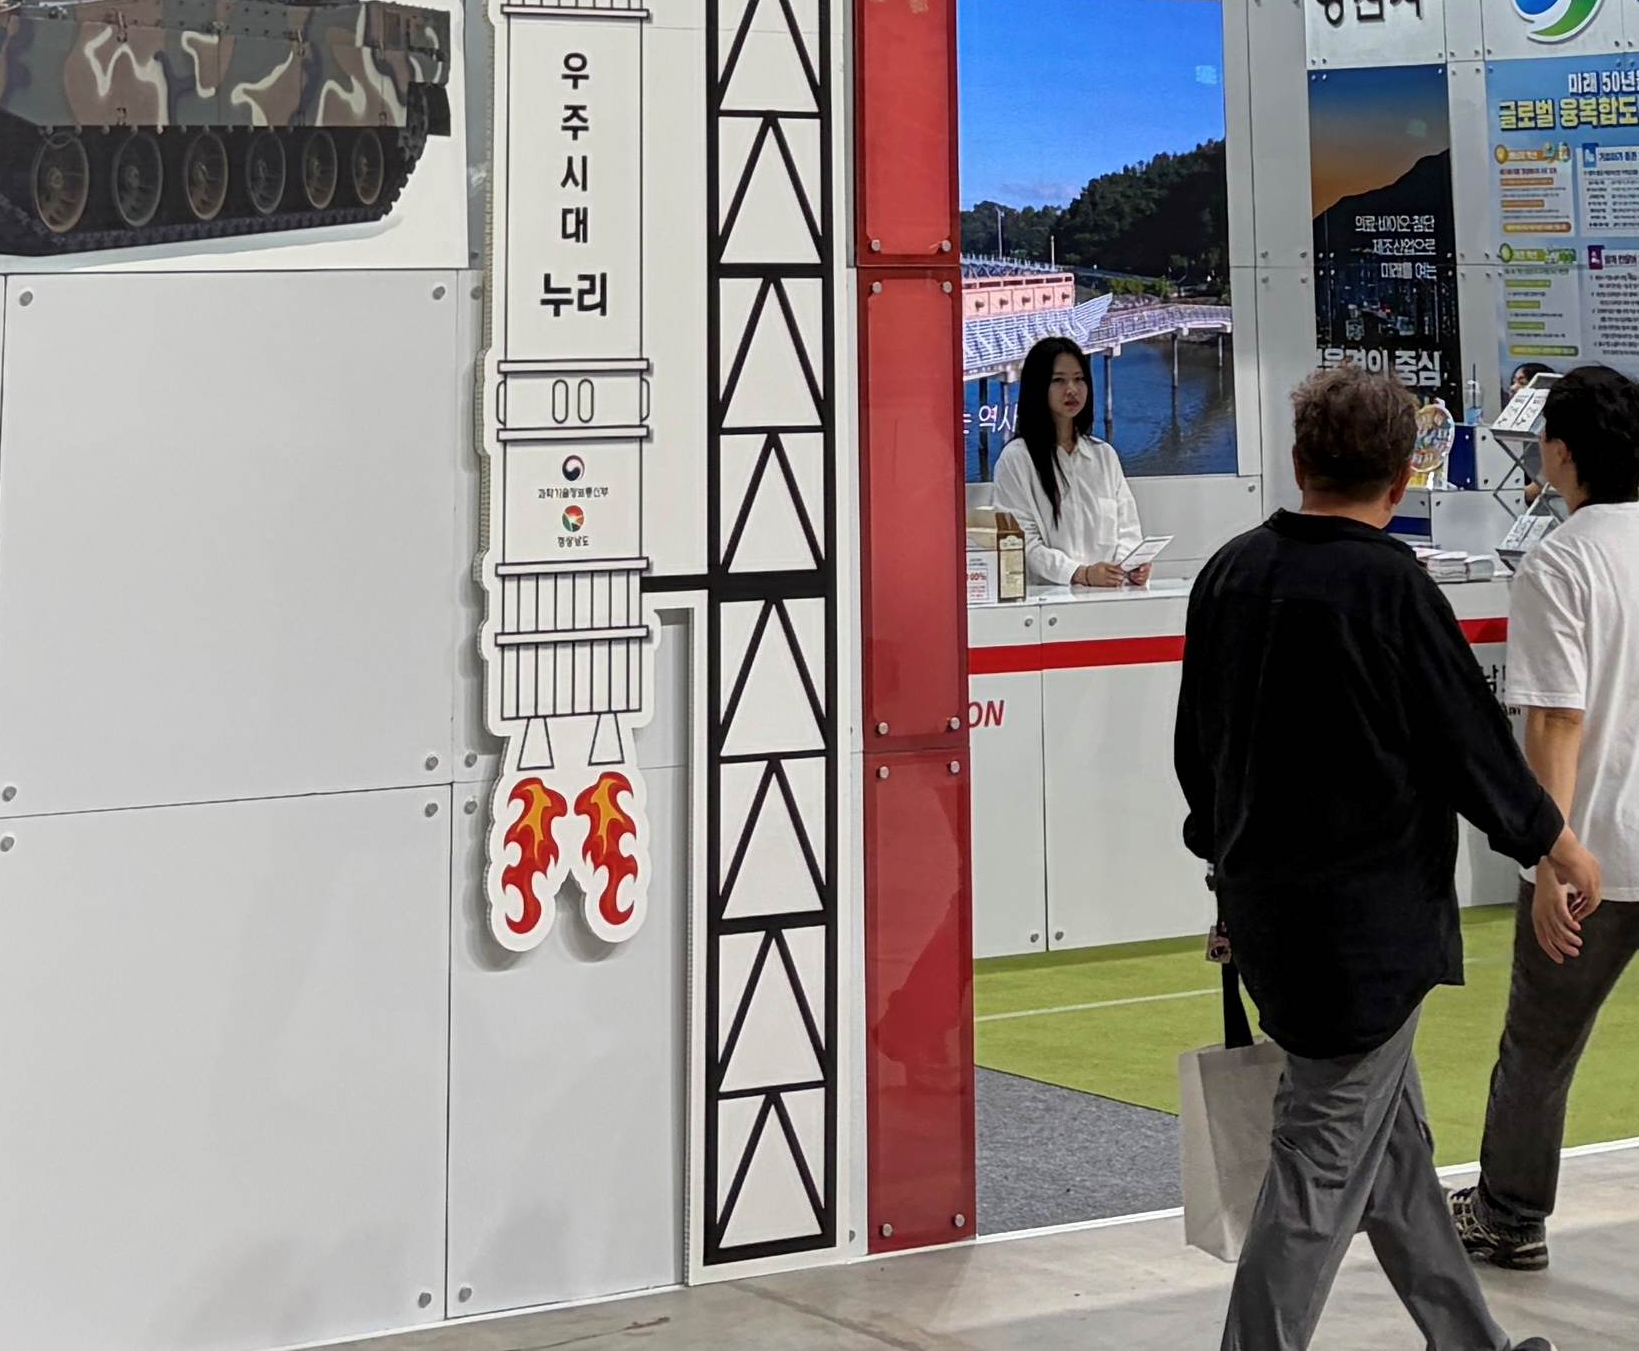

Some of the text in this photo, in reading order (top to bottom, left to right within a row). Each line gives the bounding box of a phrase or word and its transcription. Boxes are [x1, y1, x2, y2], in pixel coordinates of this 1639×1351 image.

[1568, 69, 1598, 95] 미래
[1499, 100, 1555, 130] 글로벌
[540, 272, 607, 317] 누리
[1394, 349, 1442, 387] 중심
[979, 403, 1019, 433] 역사
